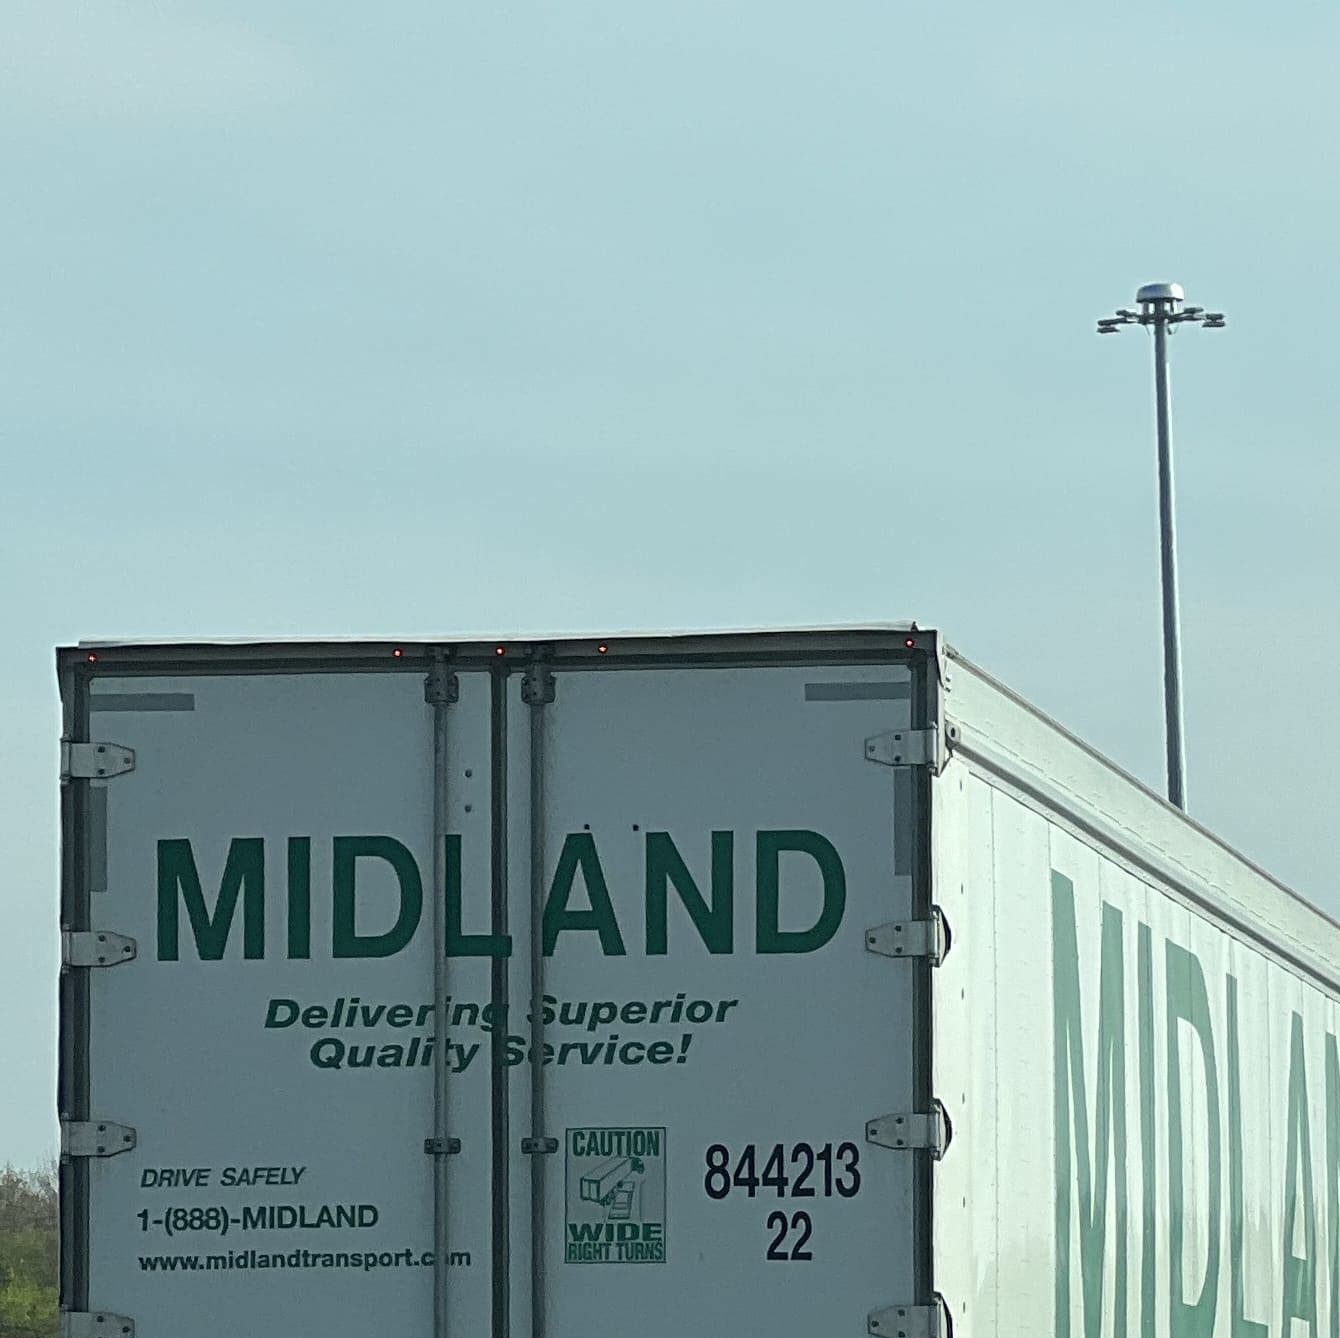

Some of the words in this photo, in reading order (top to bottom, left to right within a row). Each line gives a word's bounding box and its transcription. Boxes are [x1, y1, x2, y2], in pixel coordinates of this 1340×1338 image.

[156, 829, 847, 962] MIDLAND
[527, 993, 739, 1032] Superior
[310, 1036, 480, 1073] Quality
[502, 1033, 693, 1067] Service!
[572, 1130, 660, 1157] CAUTION
[141, 1167, 211, 1188] DRIVE
[220, 1165, 307, 1186] SAFELY
[704, 1141, 862, 1200] 844213
[137, 1204, 379, 1237] 1-(888)-MIDLAND
[567, 1223, 662, 1242] WIDE
[766, 1210, 813, 1261] 22
[138, 1247, 471, 1272] www.midlandtransport.cm
[568, 1242, 612, 1260] RIGHT
[615, 1242, 663, 1260] TURNS
